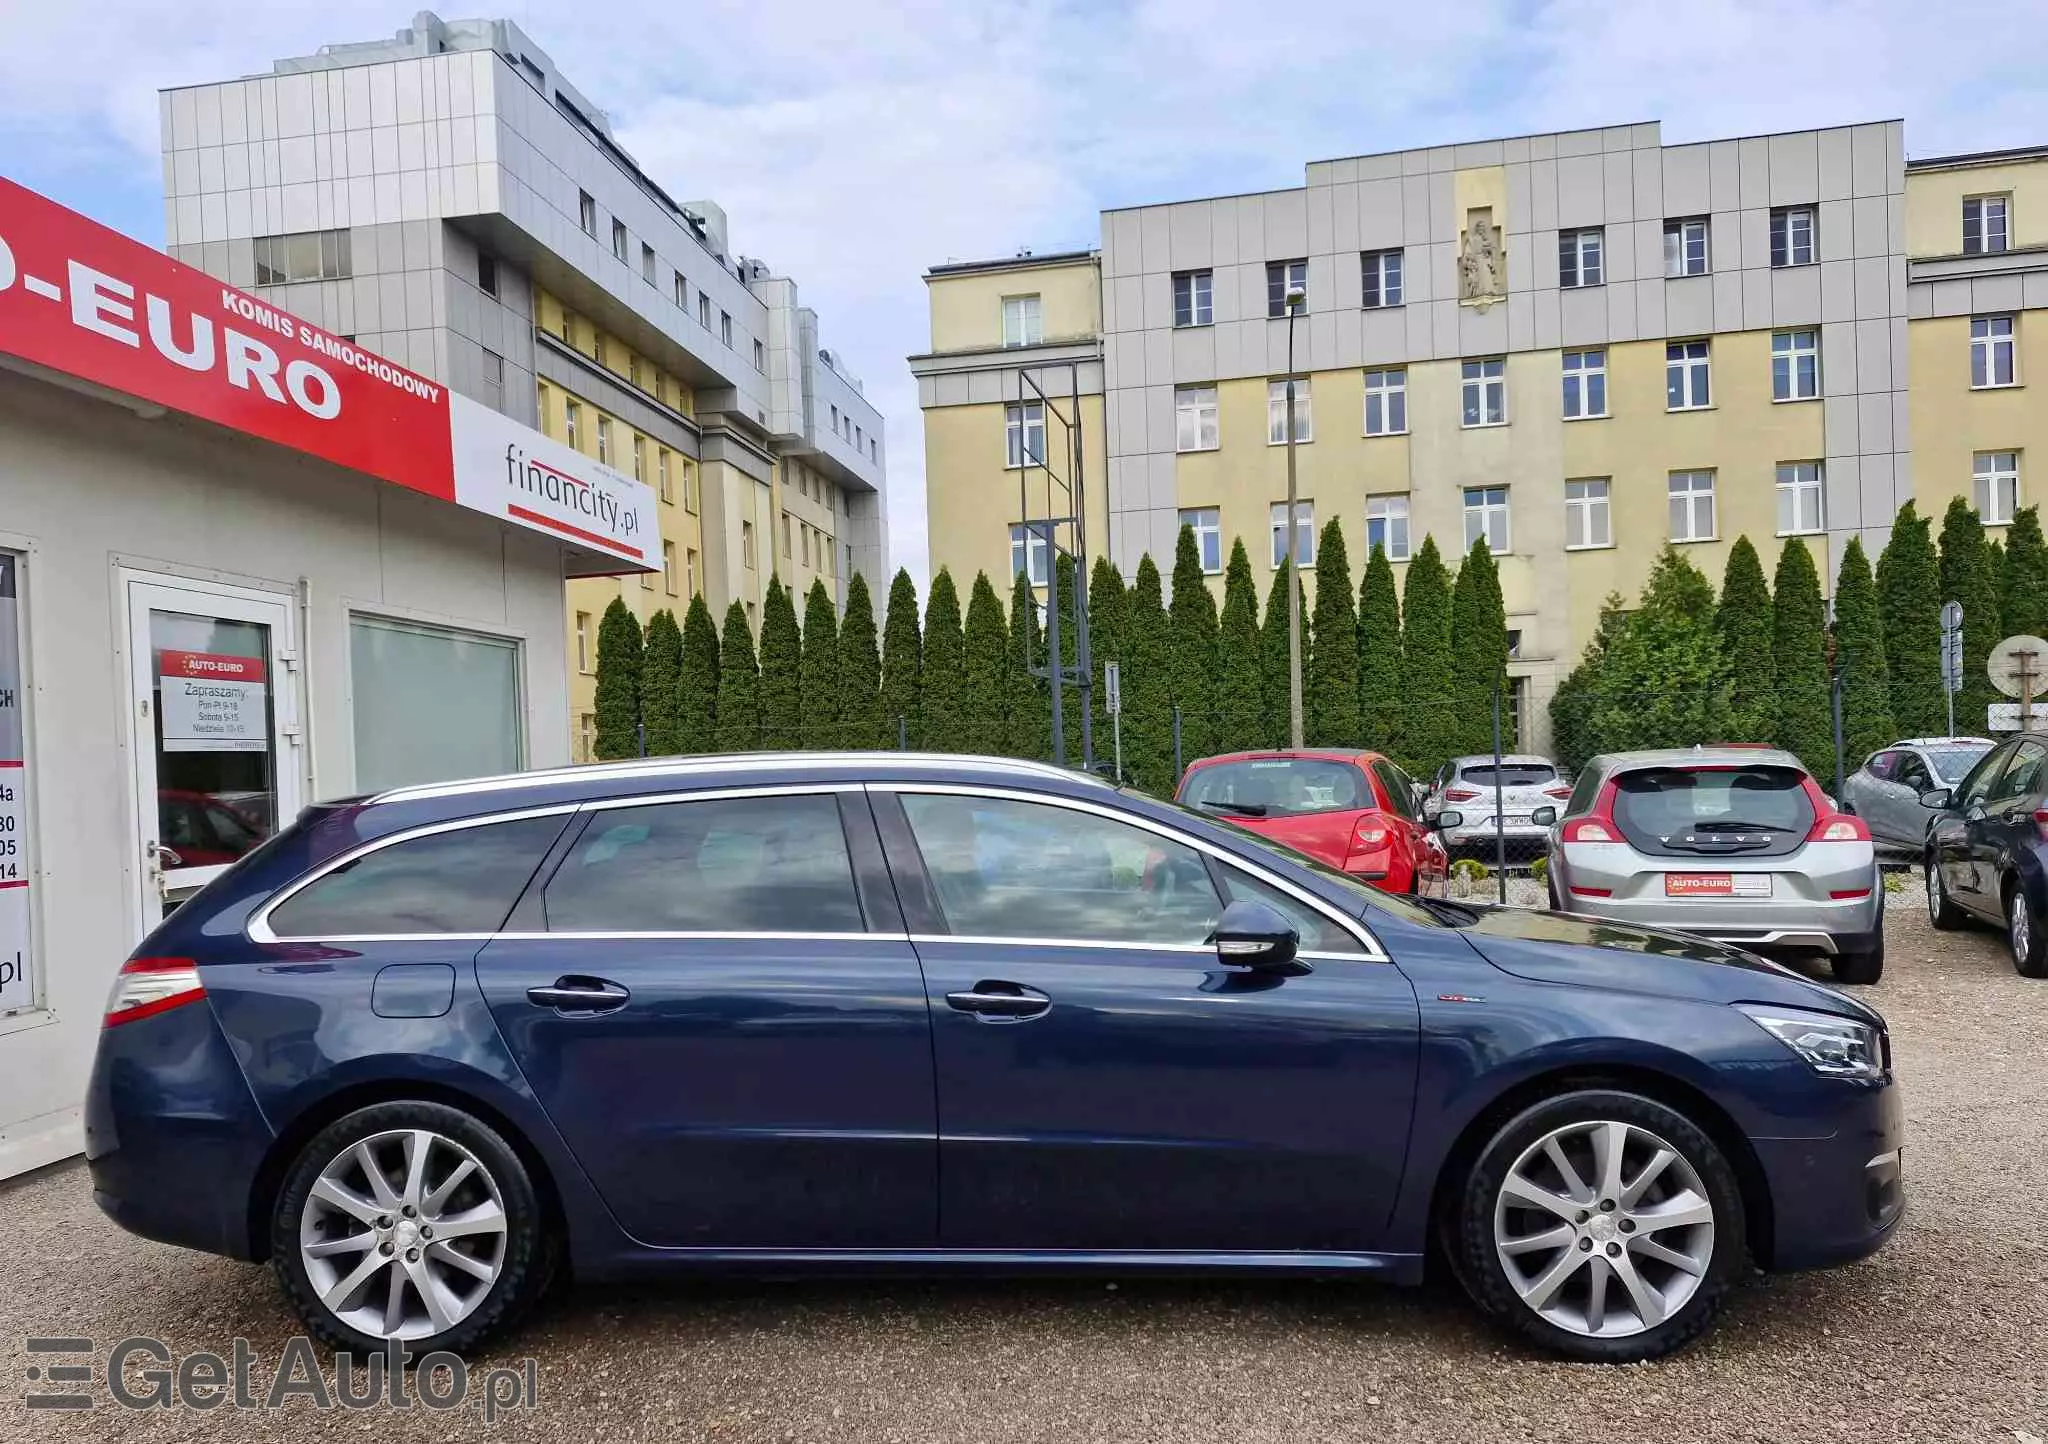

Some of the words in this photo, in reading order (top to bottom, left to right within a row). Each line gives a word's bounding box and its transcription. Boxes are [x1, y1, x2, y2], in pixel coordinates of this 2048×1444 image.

[0, 235, 341, 420] -EURO
[221, 289, 294, 338] KOMIS
[299, 325, 439, 404] SAMOCHODOWY
[505, 443, 638, 536] financity.pl
[188, 659, 244, 673] AUTO-EURO
[1673, 879, 1732, 889] AUTO-EURO
